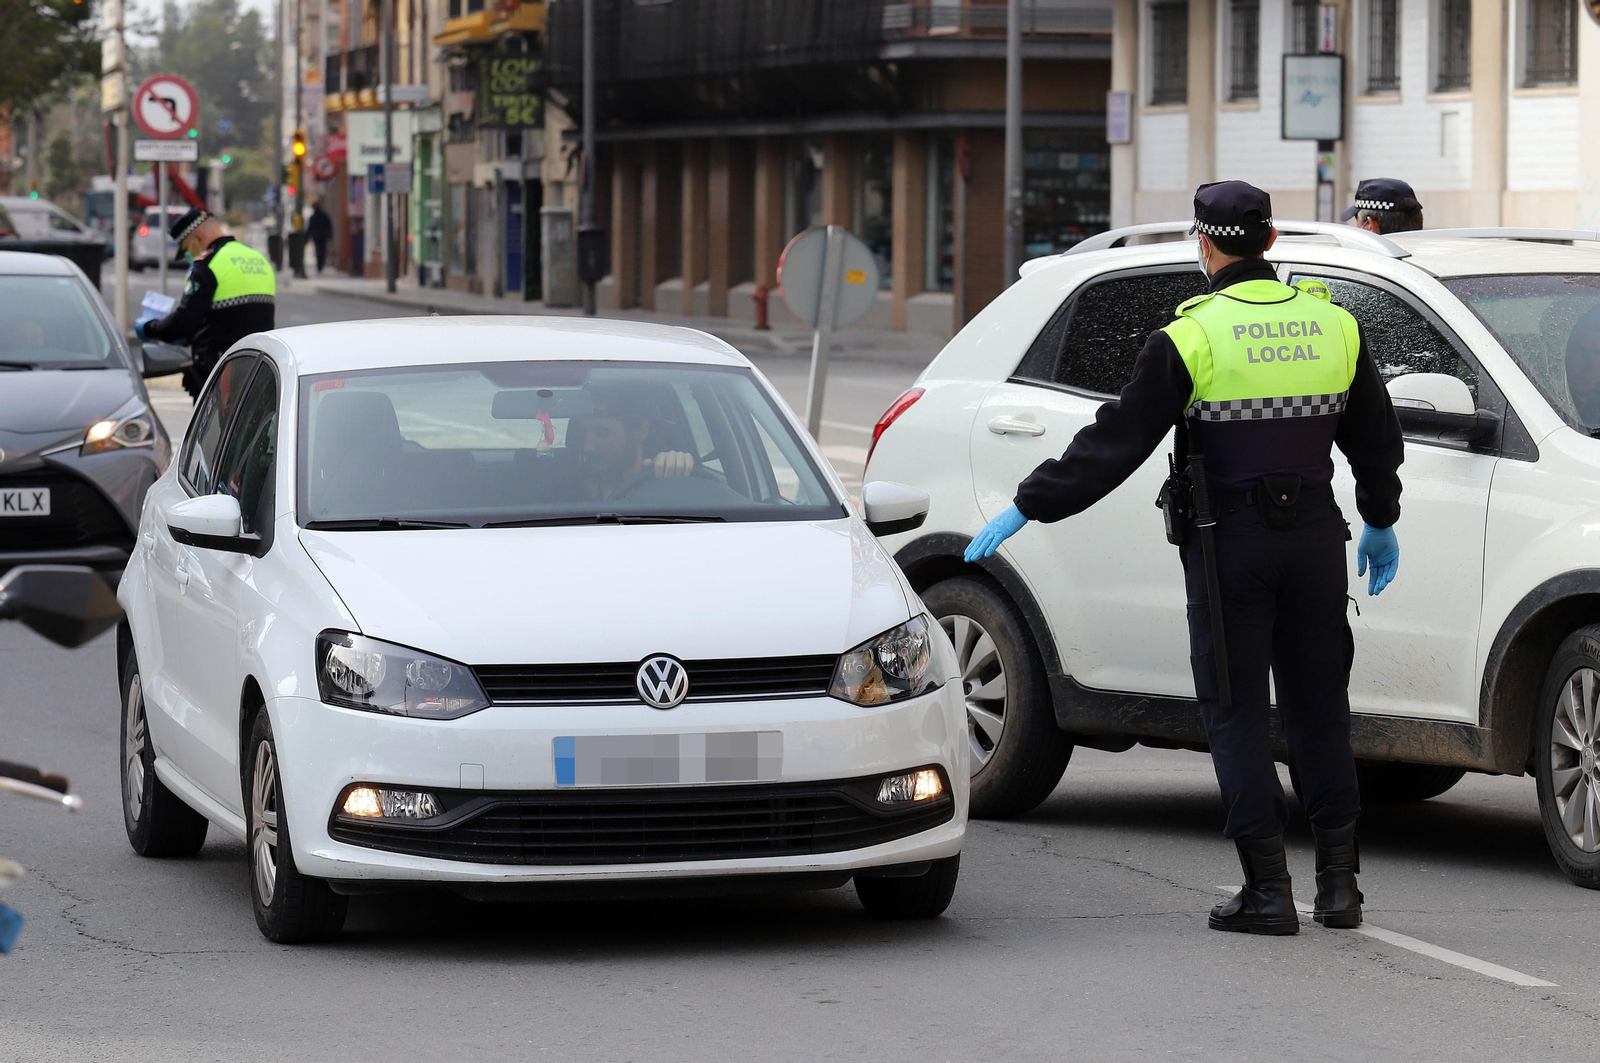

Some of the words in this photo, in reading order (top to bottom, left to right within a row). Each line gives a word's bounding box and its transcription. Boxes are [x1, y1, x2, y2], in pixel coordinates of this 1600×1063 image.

[231, 257, 266, 265] POLICIA
[241, 265, 268, 275] LOCAL
[1232, 320, 1324, 340] POLICIA
[1246, 344, 1321, 364] LOCAL
[3, 492, 44, 511] KLX
